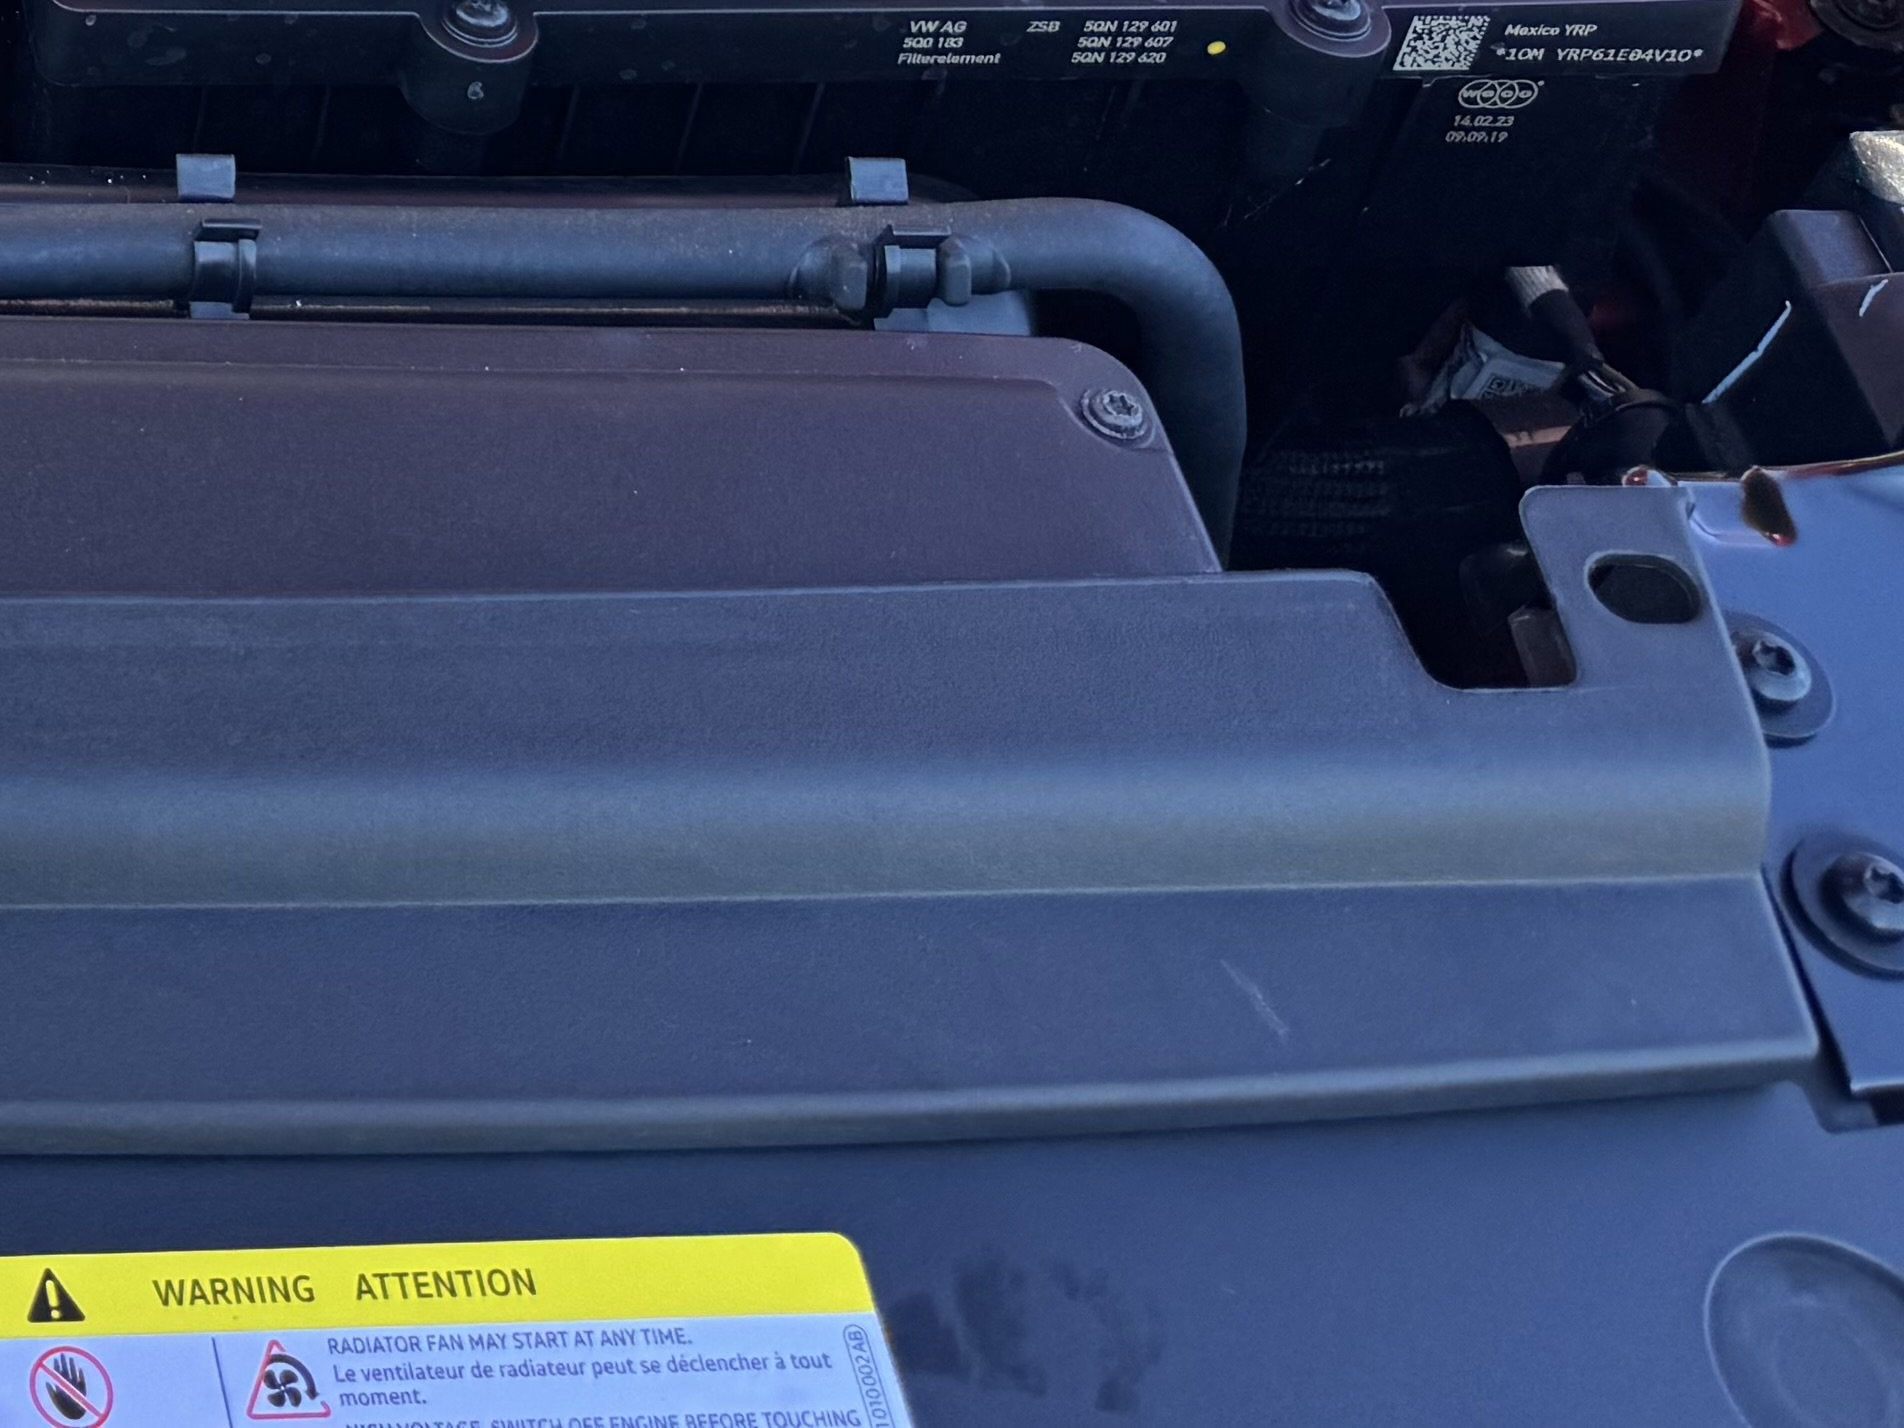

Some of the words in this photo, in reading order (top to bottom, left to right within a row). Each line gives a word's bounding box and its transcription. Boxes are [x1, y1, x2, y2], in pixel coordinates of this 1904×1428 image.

[910, 21, 939, 33] VW
[940, 21, 967, 33] AG
[1026, 21, 1061, 32] ZSB
[1504, 24, 1560, 36] Mexico
[1565, 24, 1598, 36] YRP
[897, 52, 1001, 65] Filterelement
[152, 1272, 316, 1309] WARNING
[354, 1265, 538, 1303] ATTENTION
[328, 1335, 424, 1356] RADIATOR
[427, 1334, 465, 1354] FAN
[469, 1332, 508, 1352] MAY
[514, 1331, 570, 1350] START
[574, 1330, 596, 1349] AT
[599, 1328, 639, 1348] ANY
[641, 1326, 695, 1347] TIME.
[334, 1364, 357, 1384] Le
[360, 1359, 466, 1383] ventilateur
[470, 1359, 495, 1380] de
[498, 1356, 587, 1380] radiateur
[591, 1357, 636, 1382] peut
[641, 1359, 663, 1375] se
[668, 1351, 770, 1375] déclencher
[774, 1352, 787, 1372] à
[790, 1351, 833, 1372] tout
[339, 1387, 429, 1408] moment.
[760, 1408, 860, 1428] TOUCHING
